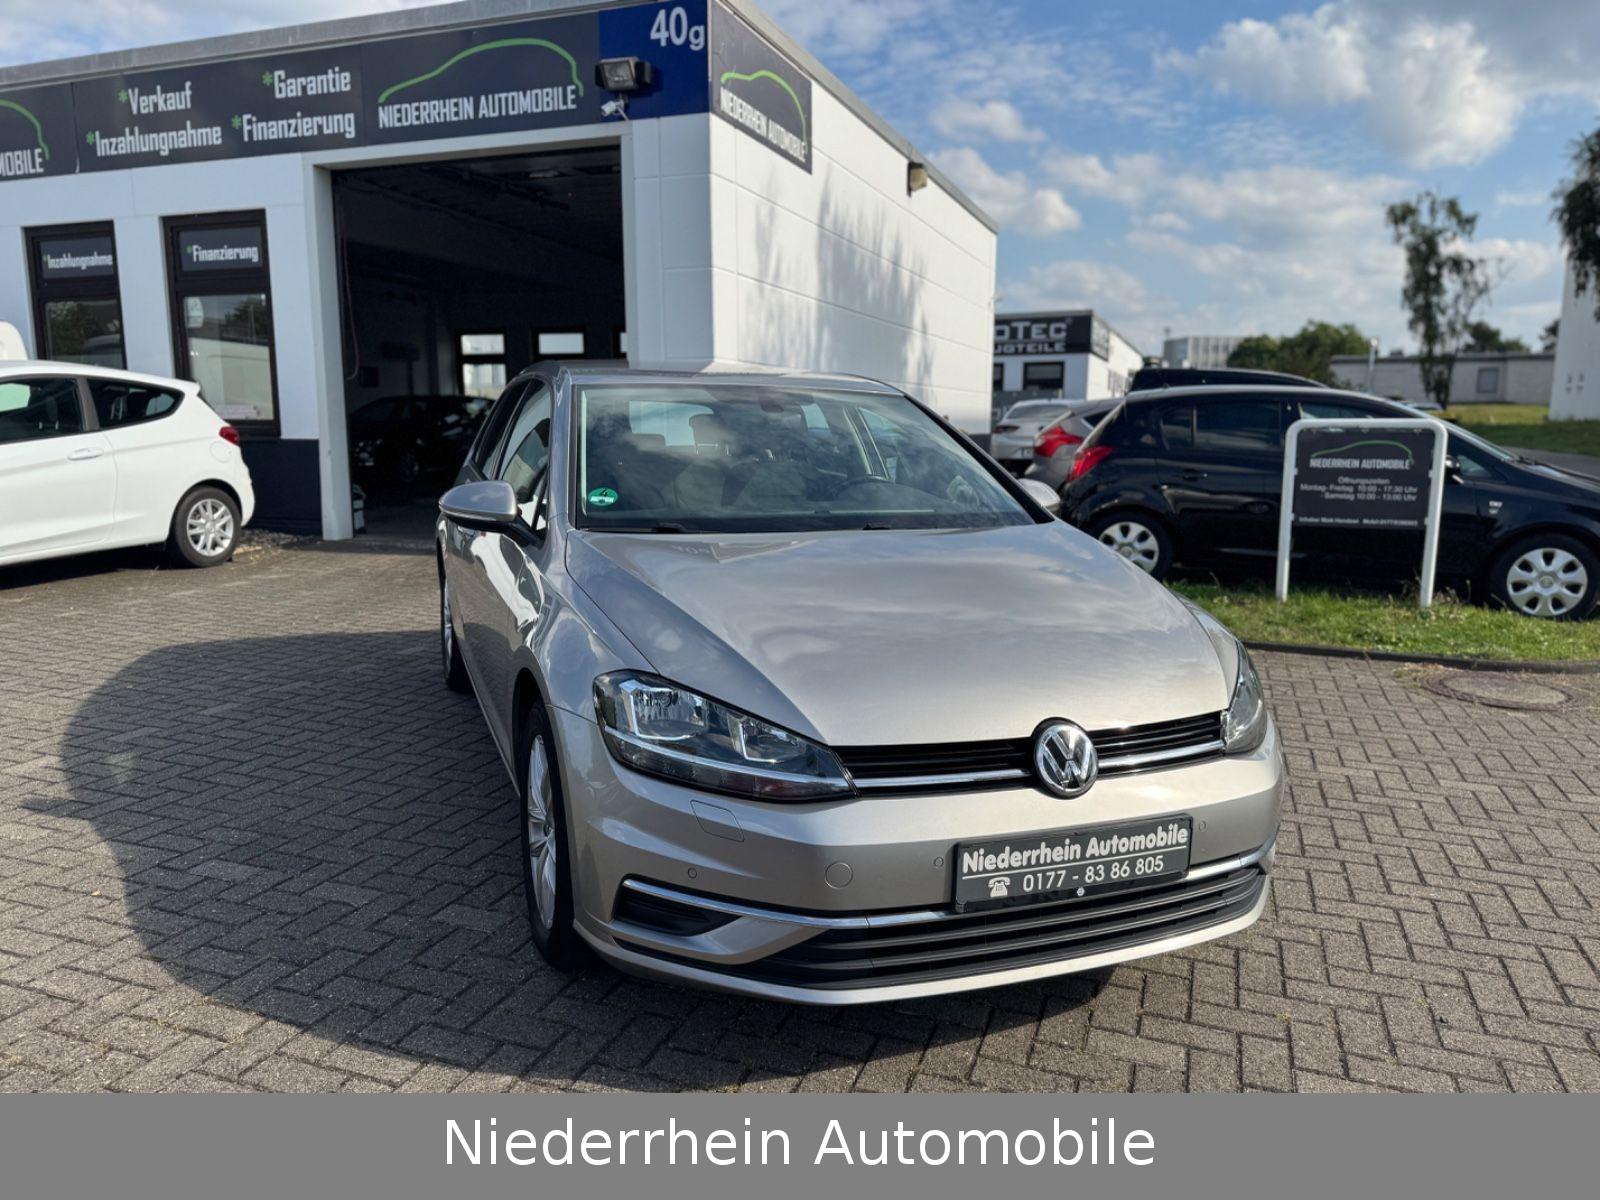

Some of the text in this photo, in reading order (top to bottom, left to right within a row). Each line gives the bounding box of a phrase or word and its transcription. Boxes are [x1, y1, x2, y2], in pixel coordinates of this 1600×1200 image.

[650, 6, 705, 51] 40g
[128, 80, 192, 115] Verkauf
[274, 66, 351, 99] Garantie
[378, 85, 577, 129] NIEDERRHEIN AUTOMOBILE
[720, 86, 806, 162] NIEDERRHEIN AUTOMOBILE
[95, 120, 222, 156] Inzahlungnahme
[242, 111, 356, 142] Finanzierung
[47, 252, 113, 270] Inzahlungnahme
[192, 245, 259, 262] Finanzierung
[1309, 458, 1410, 470] NIEDERRHEIN AUTOMOBILE
[962, 823, 1188, 873] Niederrhein Automobile
[1022, 870, 1067, 892] 0177
[1085, 865, 1106, 884] 83
[1110, 860, 1131, 879] 86
[1135, 855, 1164, 874] 805
